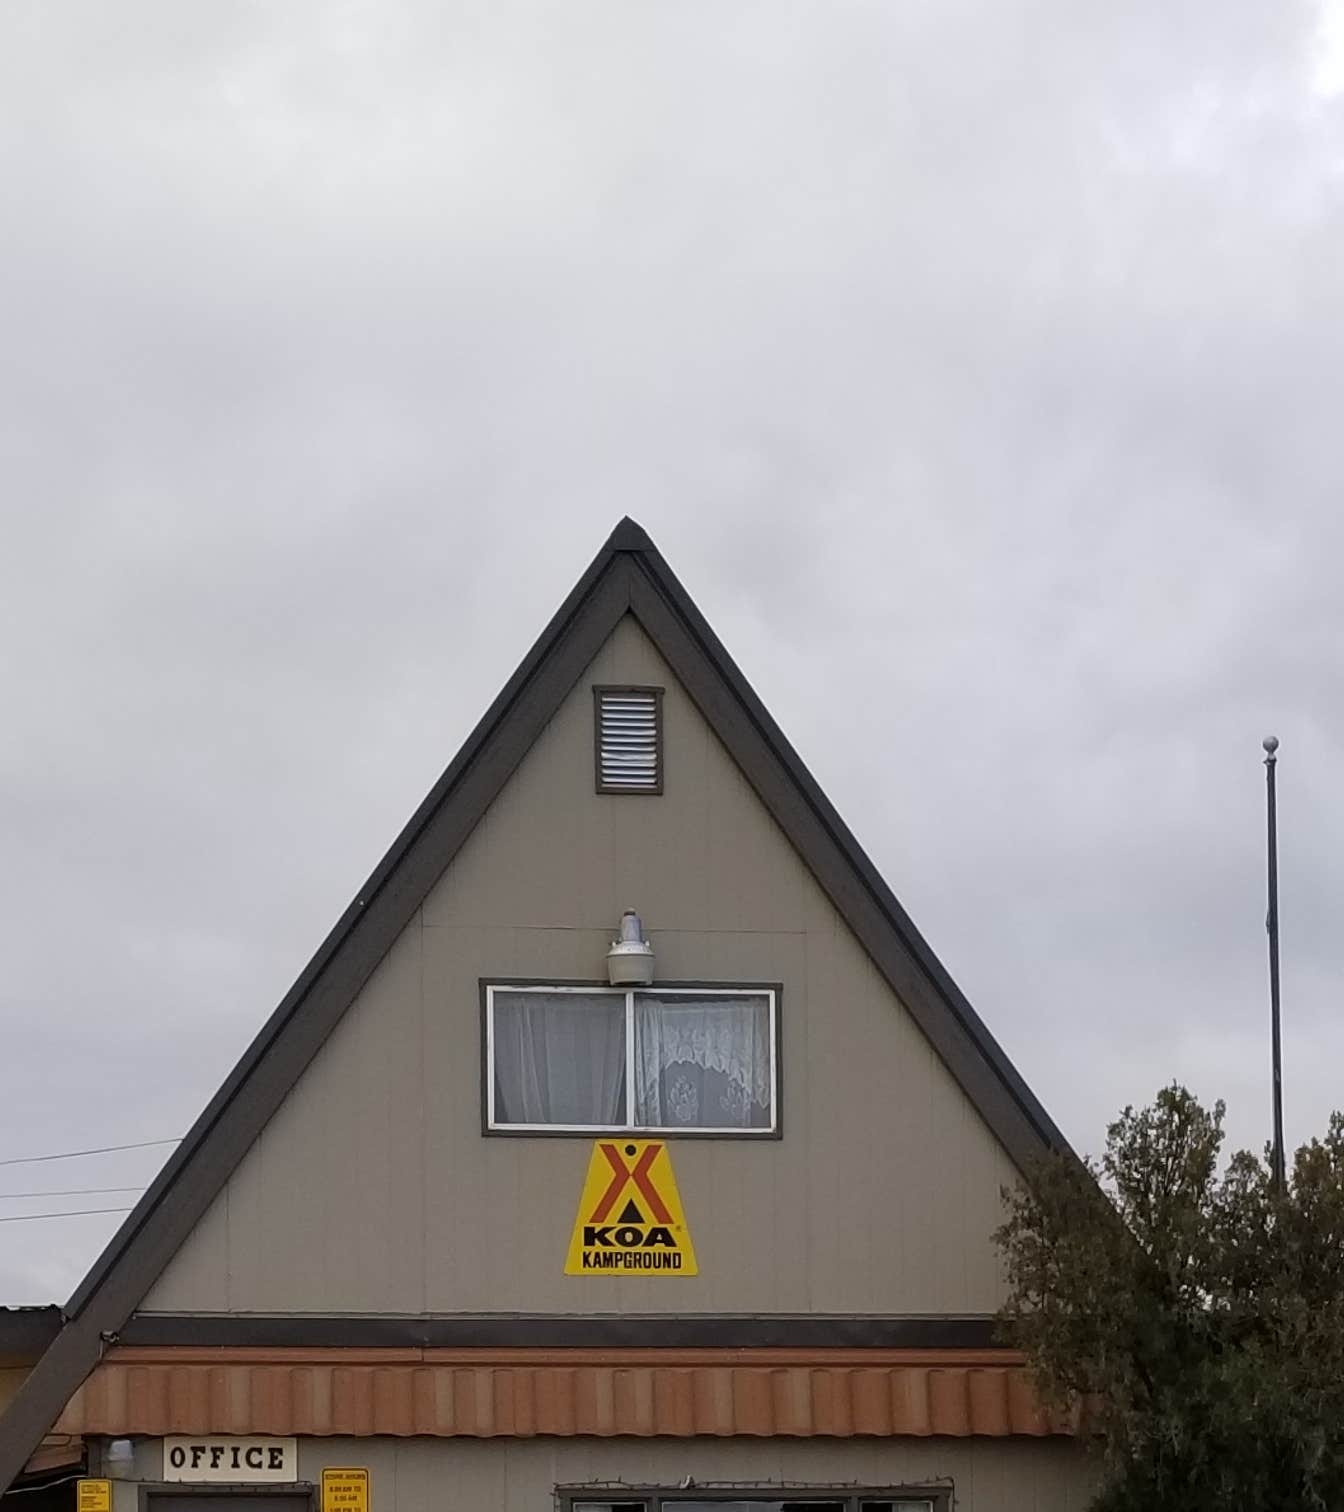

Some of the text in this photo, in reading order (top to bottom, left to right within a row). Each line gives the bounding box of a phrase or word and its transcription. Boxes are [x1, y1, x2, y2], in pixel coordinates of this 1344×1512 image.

[584, 1226, 677, 1247] KOA
[582, 1251, 681, 1269] KAMPGROUND
[170, 1445, 284, 1469] OFFICE
